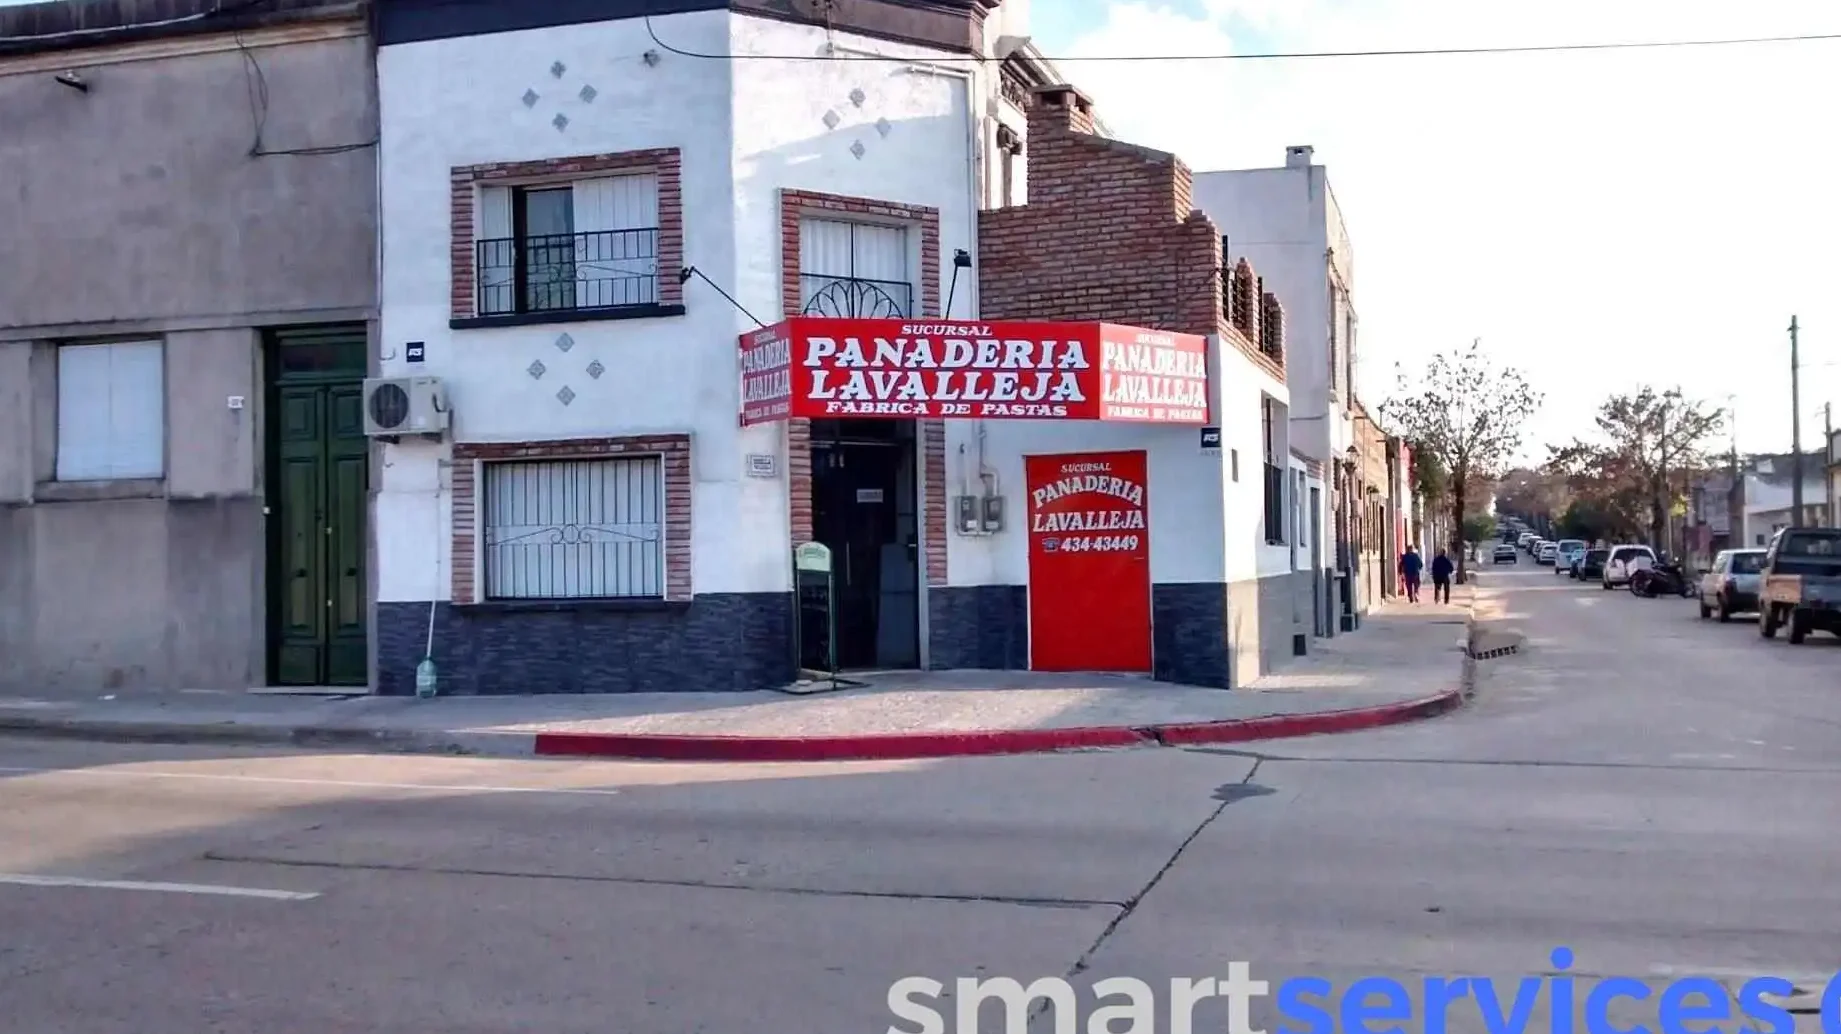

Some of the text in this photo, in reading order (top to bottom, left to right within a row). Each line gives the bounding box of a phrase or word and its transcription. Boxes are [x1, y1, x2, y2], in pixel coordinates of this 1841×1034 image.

[901, 324, 993, 336] SUCURSAL
[803, 337, 1090, 368] PANADERIA
[1103, 341, 1206, 379] PANADERIA
[807, 370, 1086, 401] LAVALLEJA
[1103, 373, 1207, 408] LAVALLEJA
[826, 401, 1068, 417] FABRICA DE PASTAS
[1061, 463, 1111, 472] SUCURSAL
[1032, 475, 1143, 509] PANADERIA
[1033, 510, 1145, 532] LAVALLEJA
[1061, 534, 1139, 552] 434-43449
